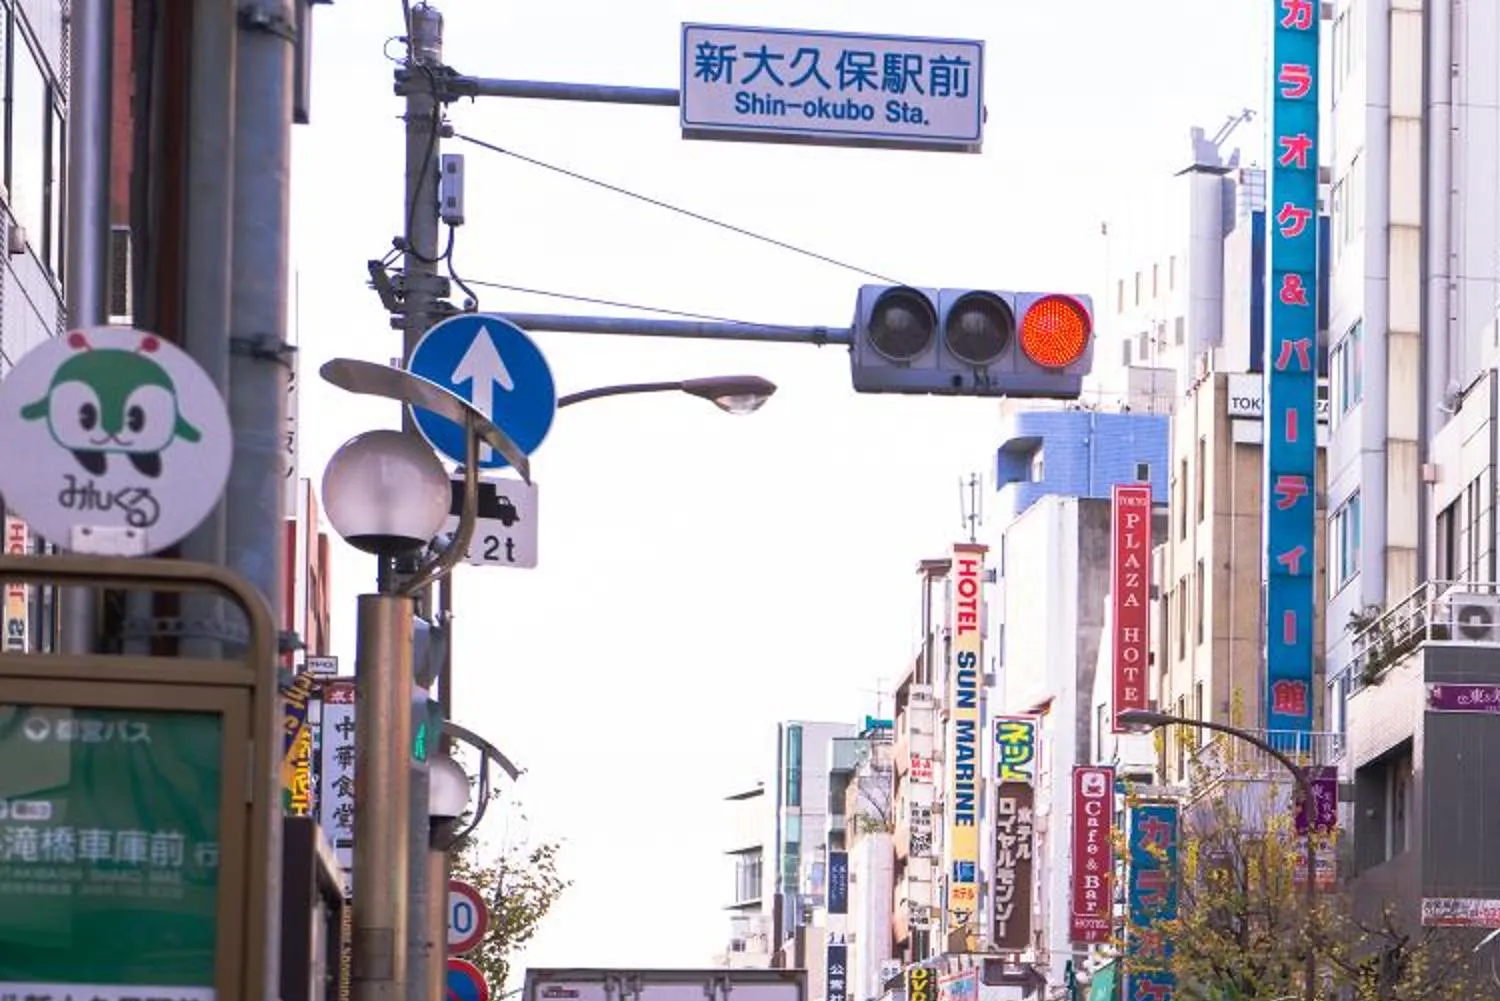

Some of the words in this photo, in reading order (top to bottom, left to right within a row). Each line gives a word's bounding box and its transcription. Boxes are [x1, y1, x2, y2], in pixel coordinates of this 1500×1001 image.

[694, 41, 972, 98] 新大久保駅前
[735, 92, 874, 121] Shin-okubo
[885, 101, 930, 126] Sta.
[1232, 397, 1264, 410] TOK
[1123, 513, 1141, 607] PLAZA
[956, 559, 978, 636] HOTEL
[956, 651, 977, 709] SUN
[1123, 628, 1141, 701] HOTE
[955, 720, 977, 827] MARINE
[0, 826, 185, 868] 滝橋車庫前
[1084, 801, 1101, 855] Cafe
[1084, 875, 1101, 912] Bar
